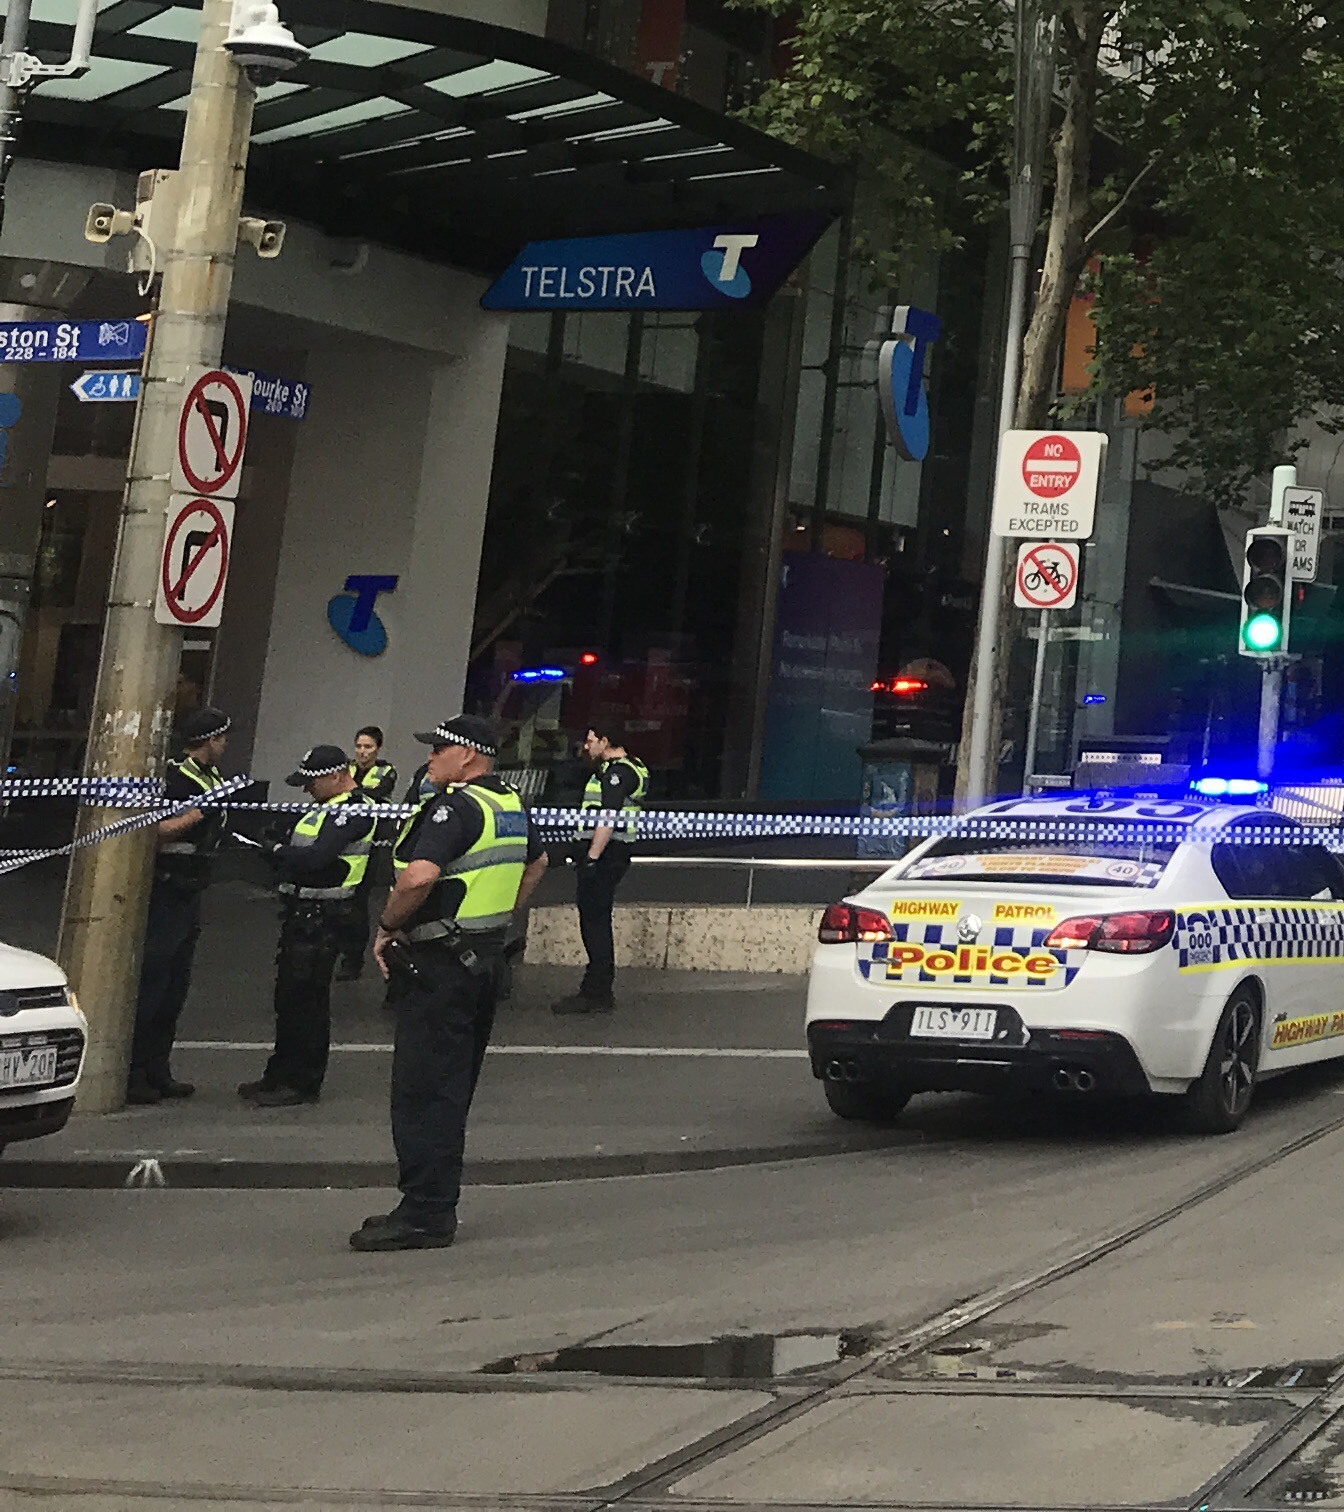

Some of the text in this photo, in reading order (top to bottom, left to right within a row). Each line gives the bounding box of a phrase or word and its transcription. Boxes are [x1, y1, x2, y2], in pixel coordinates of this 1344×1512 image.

[520, 266, 657, 298] TELSTRA
[55, 324, 81, 348] St
[5, 347, 34, 360] 228
[51, 347, 78, 360] 184
[292, 383, 309, 408] St
[1044, 443, 1064, 458] NO
[1029, 474, 1074, 489] ENTRY
[1022, 501, 1070, 516] TRAMS
[1008, 518, 1079, 533] EXCEPTED
[1294, 539, 1307, 552] OR
[1292, 556, 1314, 572] AMS
[1112, 865, 1135, 875] 40
[893, 901, 1055, 919] HIGHWAY PATROL
[1189, 932, 1212, 950] 000
[889, 945, 1059, 975] Police
[1273, 1016, 1330, 1044] HIGHWAY
